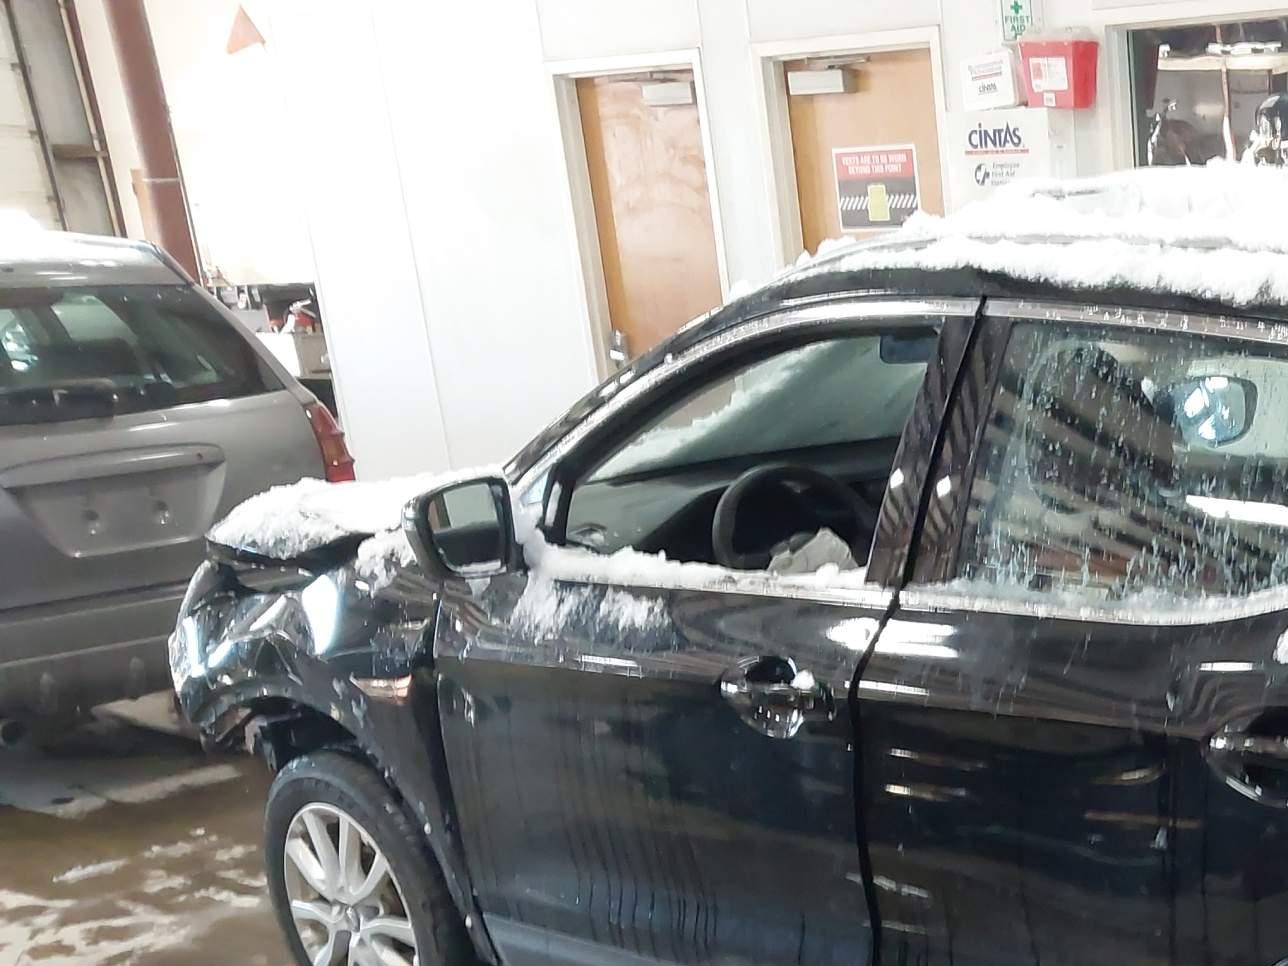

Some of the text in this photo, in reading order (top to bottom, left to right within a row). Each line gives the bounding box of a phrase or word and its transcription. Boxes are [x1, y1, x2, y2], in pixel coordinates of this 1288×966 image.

[1004, 15, 1030, 24] FIRST
[1010, 24, 1026, 32] AID
[968, 122, 1022, 149] CINTAS
